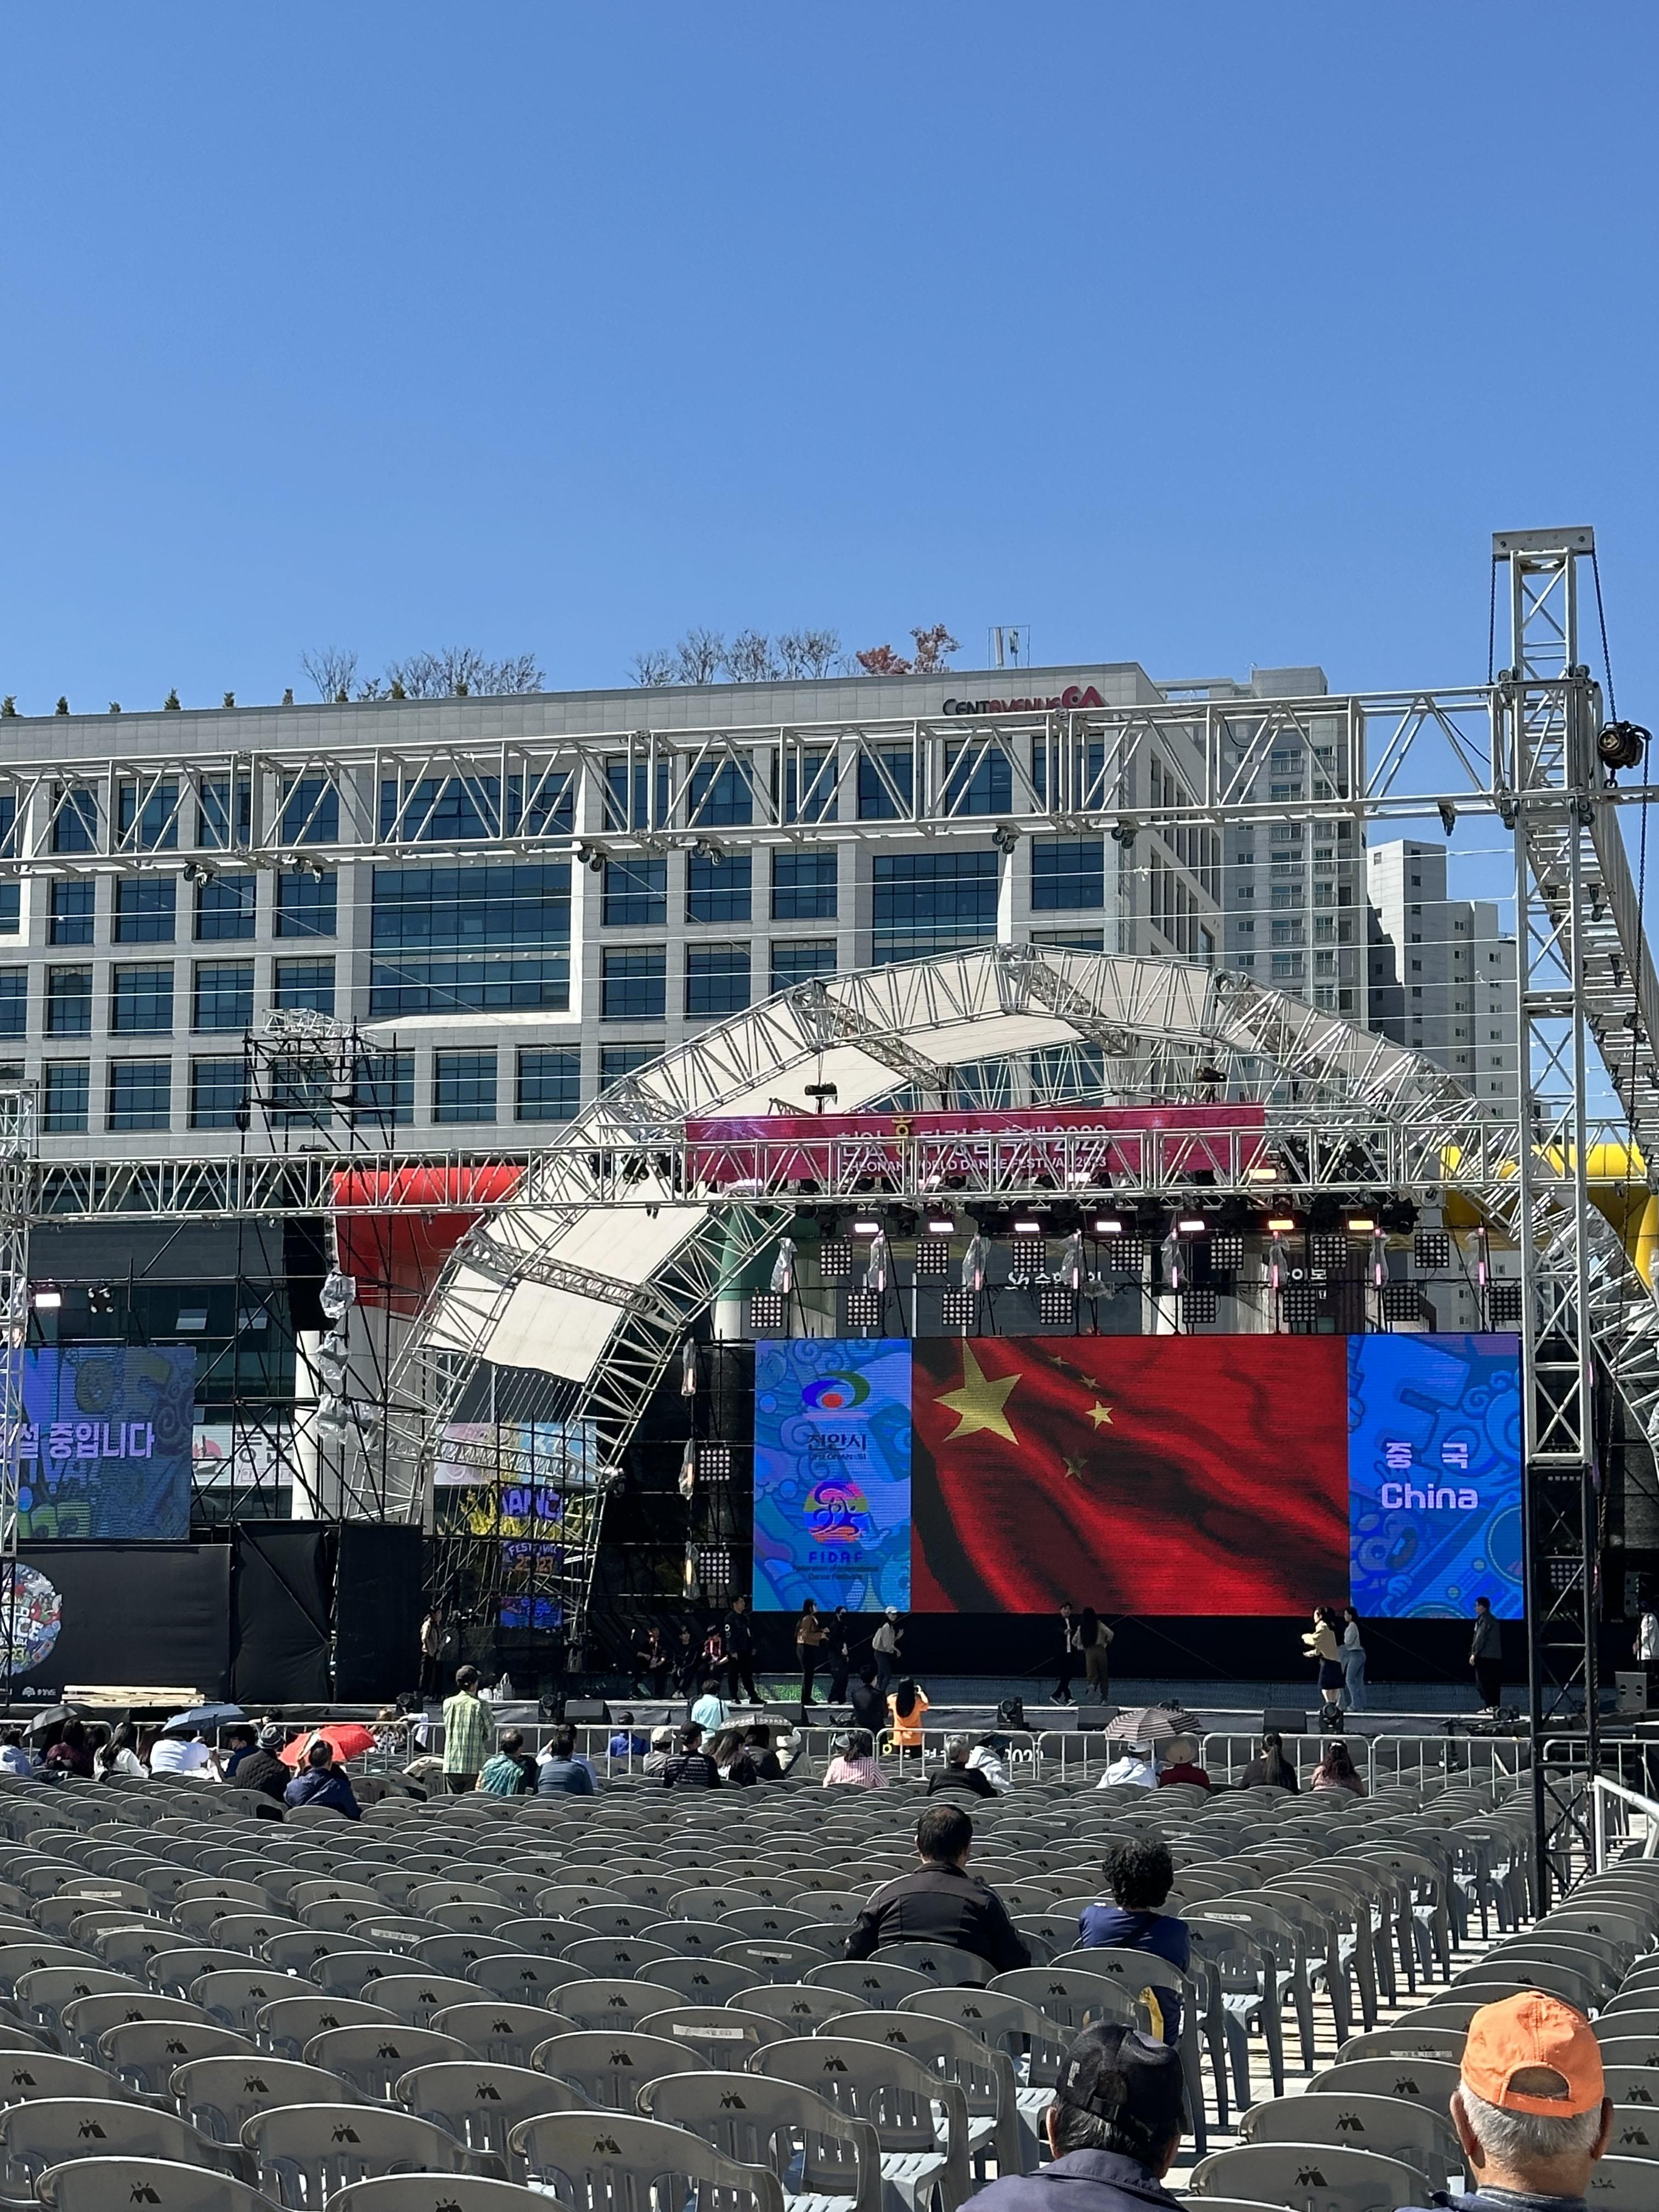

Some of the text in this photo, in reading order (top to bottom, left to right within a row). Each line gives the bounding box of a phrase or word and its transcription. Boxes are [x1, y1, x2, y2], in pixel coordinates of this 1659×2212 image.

[910, 1159, 958, 1171] ORLD
[49, 1422, 155, 1459] 중입니다
[808, 1433, 867, 1451] 천안시
[1381, 1482, 1479, 1510] China
[809, 1551, 864, 1563] FIDAF
